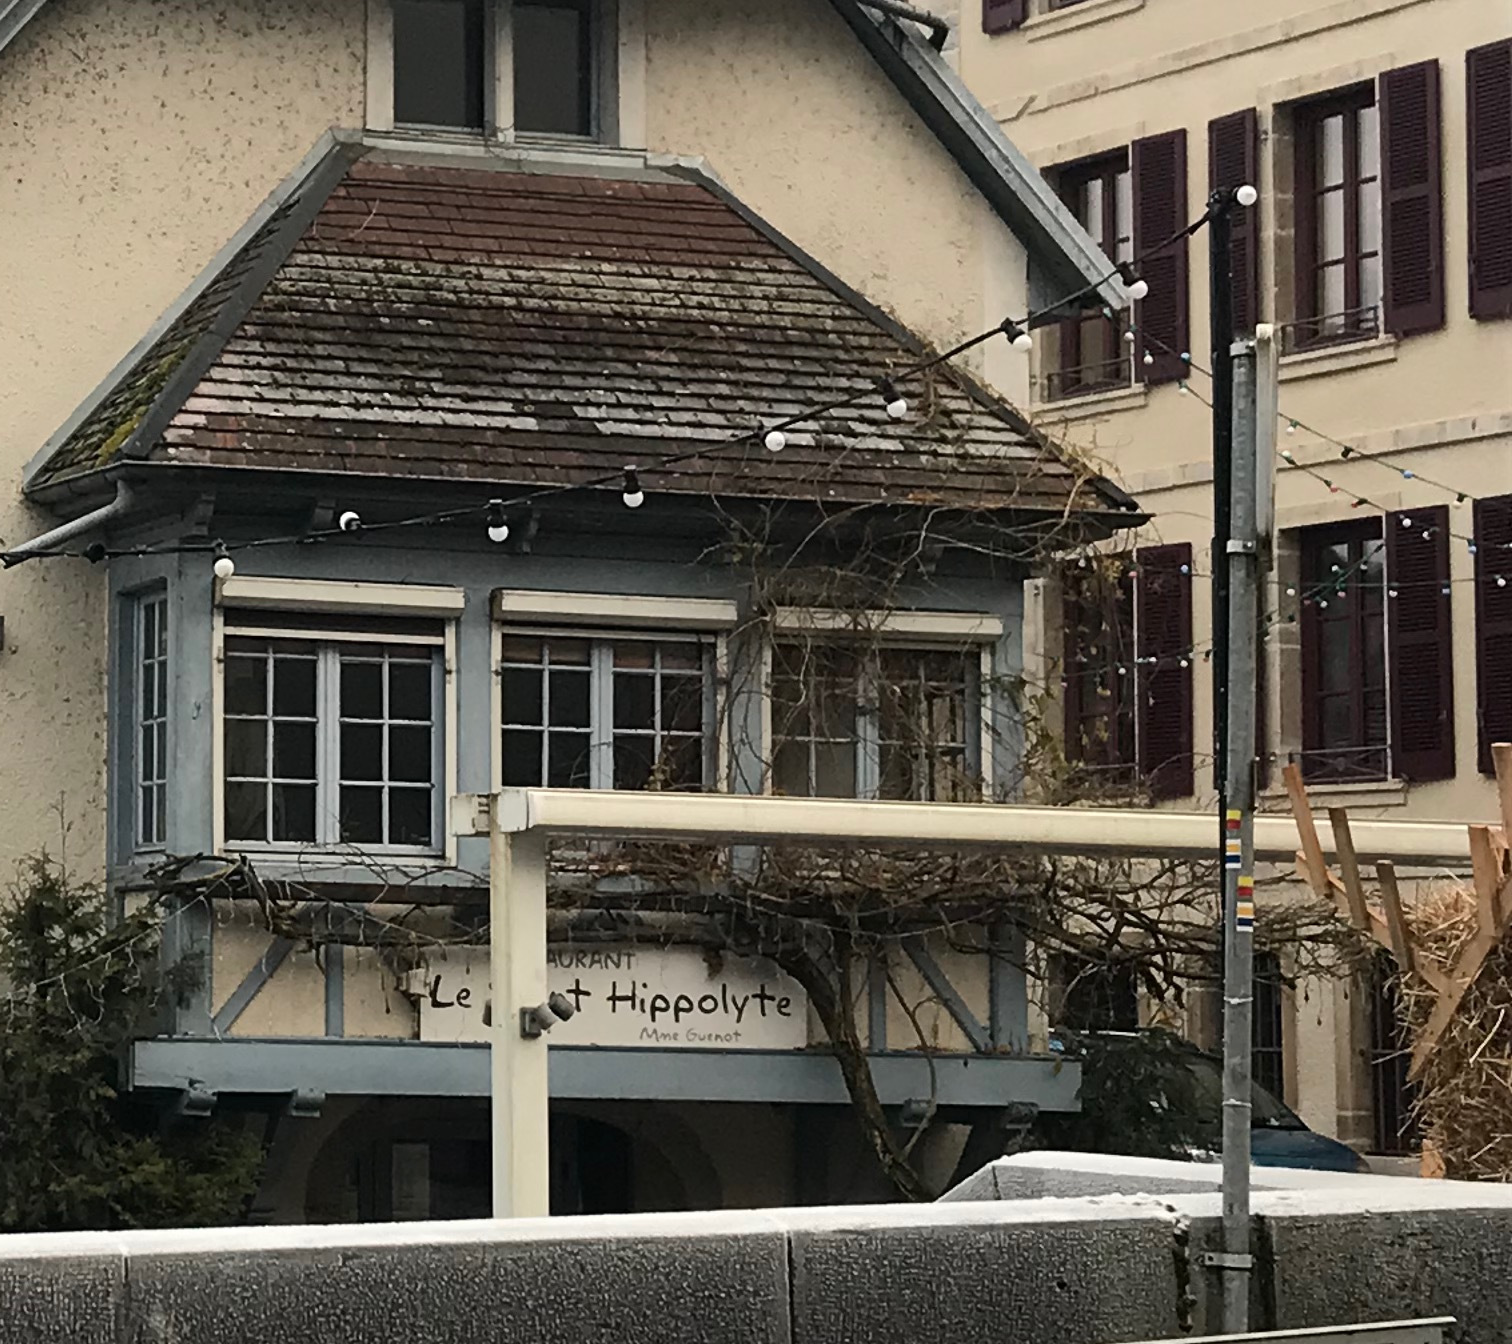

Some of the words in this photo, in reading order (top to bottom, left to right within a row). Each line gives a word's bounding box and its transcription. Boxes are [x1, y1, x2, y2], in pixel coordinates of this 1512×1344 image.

[547, 949, 636, 970] AURANT
[430, 974, 471, 1009] Le
[606, 979, 792, 1024] Hippolyte
[639, 1026, 679, 1043] Mme
[685, 1027, 743, 1043] Guenot
